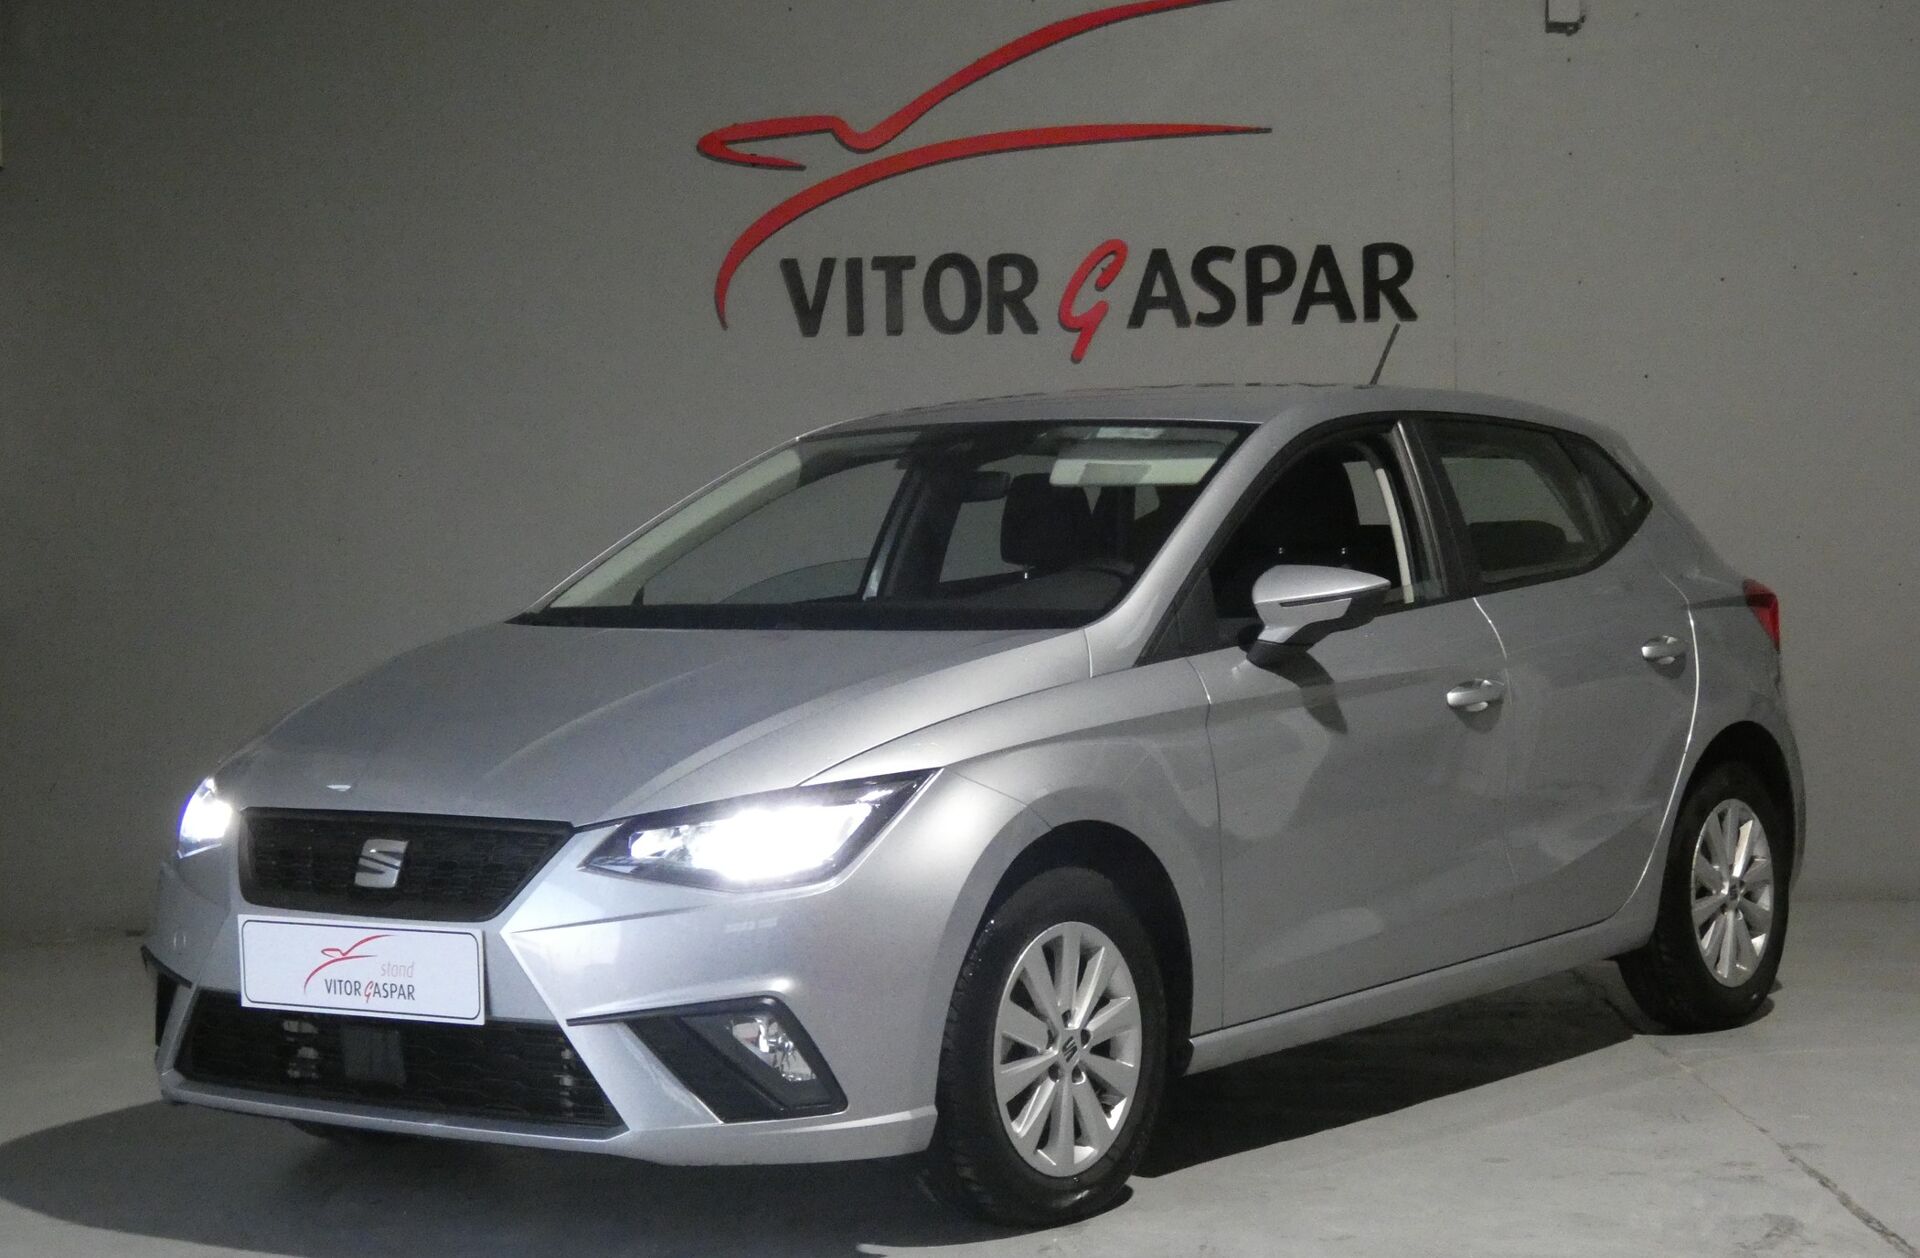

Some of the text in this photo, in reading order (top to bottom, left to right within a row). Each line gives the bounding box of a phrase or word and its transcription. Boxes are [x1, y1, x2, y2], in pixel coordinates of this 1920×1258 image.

[780, 238, 1418, 364] VITOR GASPAR
[324, 978, 415, 1003] VITOR GASPAR
